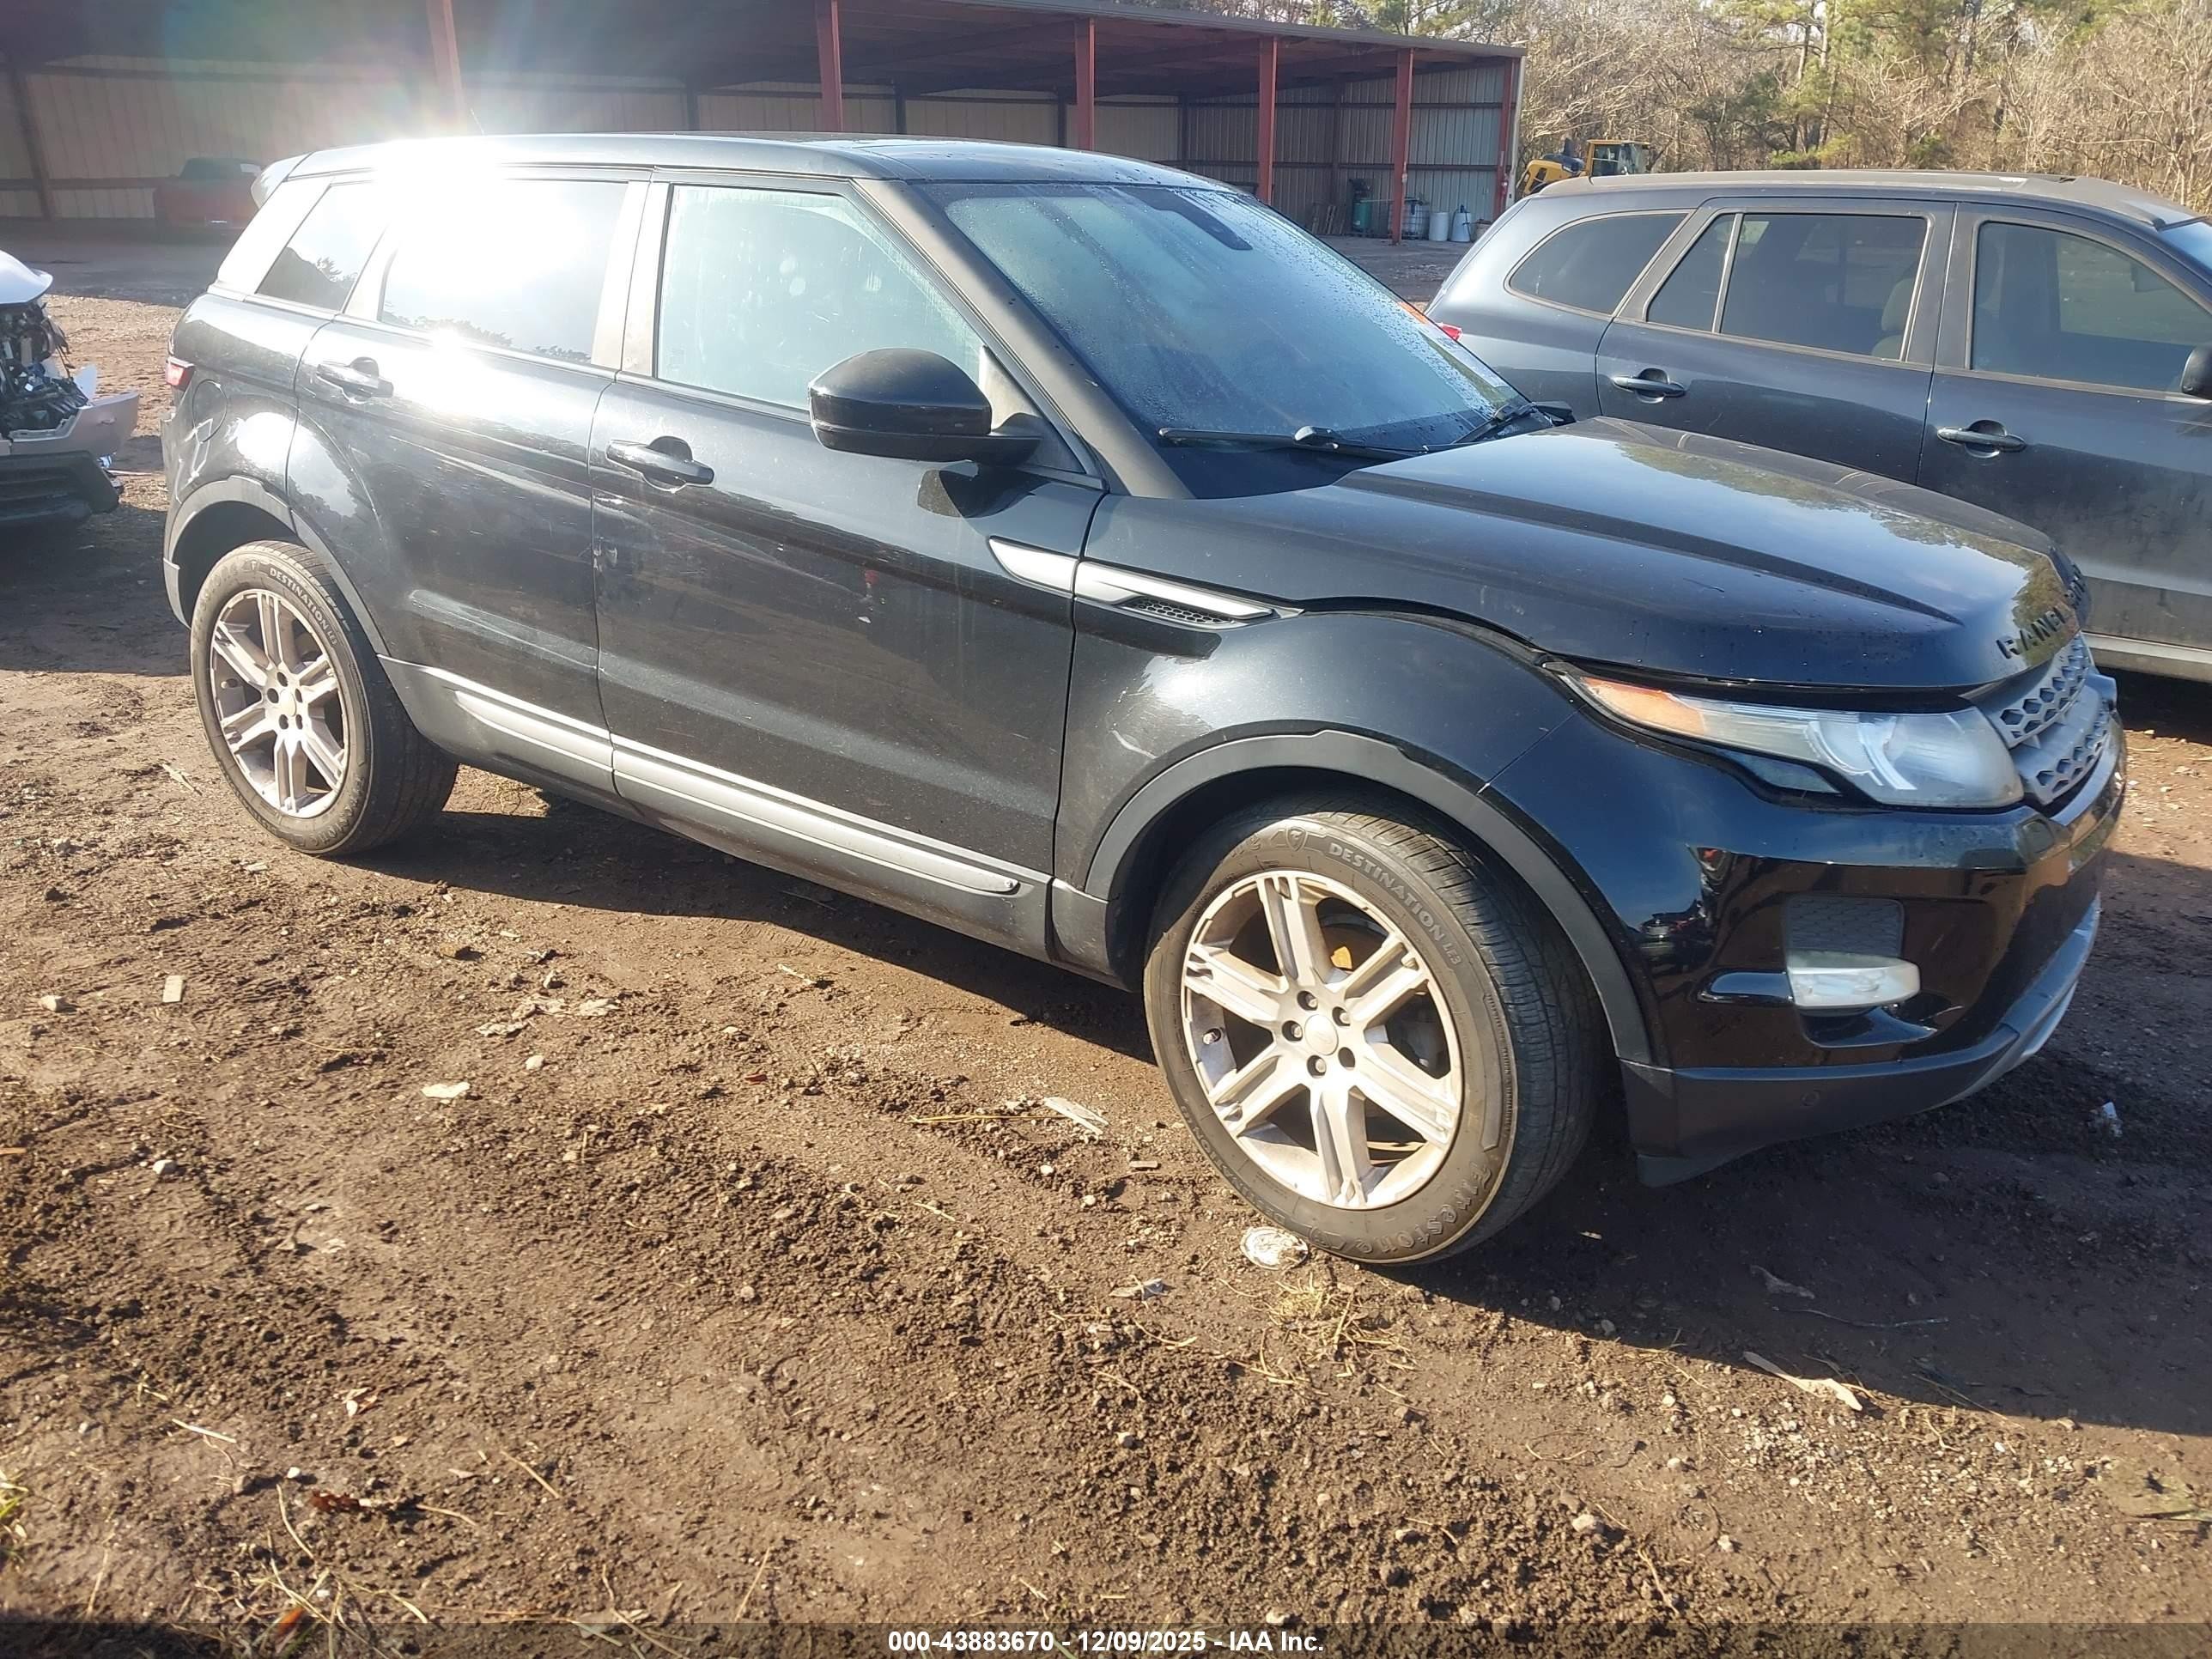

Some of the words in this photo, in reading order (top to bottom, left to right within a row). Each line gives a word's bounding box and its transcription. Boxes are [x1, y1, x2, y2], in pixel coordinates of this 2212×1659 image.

[270, 568, 330, 629] DESTINATION
[1328, 842, 1446, 942] DESTINATION
[1355, 1161, 1492, 1254] Firestone
